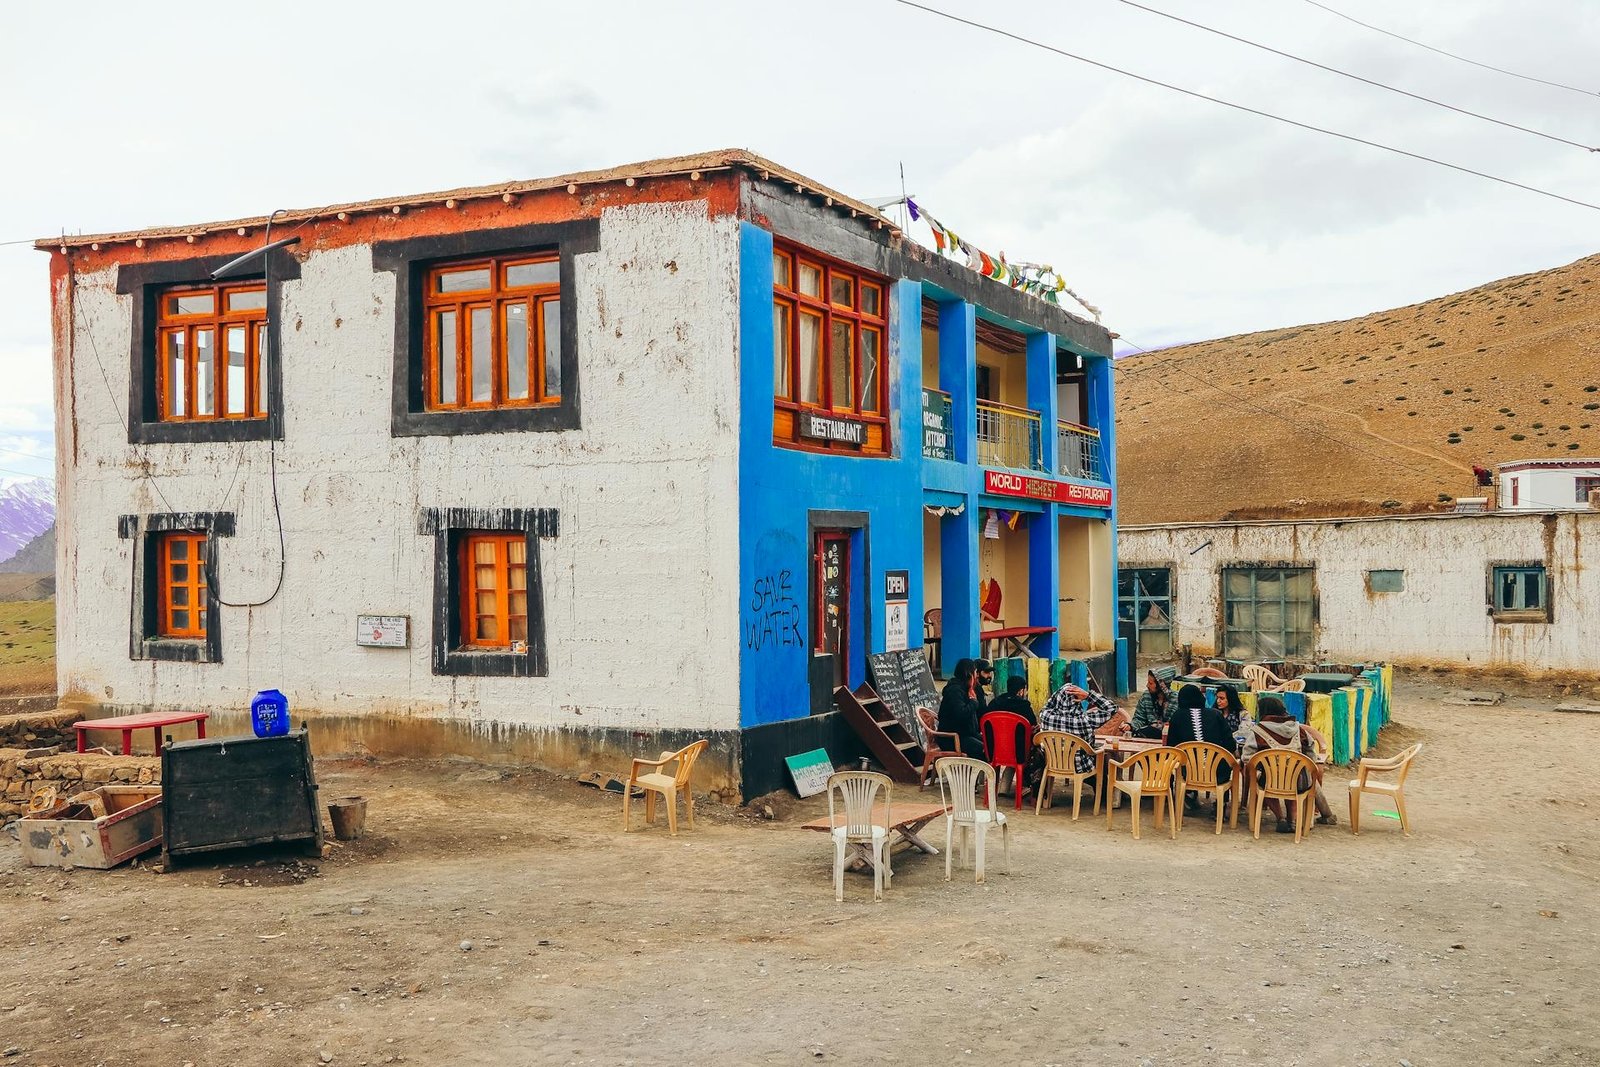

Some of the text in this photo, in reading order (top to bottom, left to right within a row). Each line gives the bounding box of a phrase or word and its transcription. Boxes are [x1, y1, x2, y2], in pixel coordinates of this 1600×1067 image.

[810, 416, 862, 442] RESTAURANT
[923, 411, 943, 430] ORGANIC
[925, 429, 946, 448] KITCHEN
[990, 472, 1109, 502] WORLD HIGHEST RESTAURANT
[752, 570, 793, 612] SAVE
[887, 576, 905, 594] OPEN
[746, 605, 804, 652] WATER
